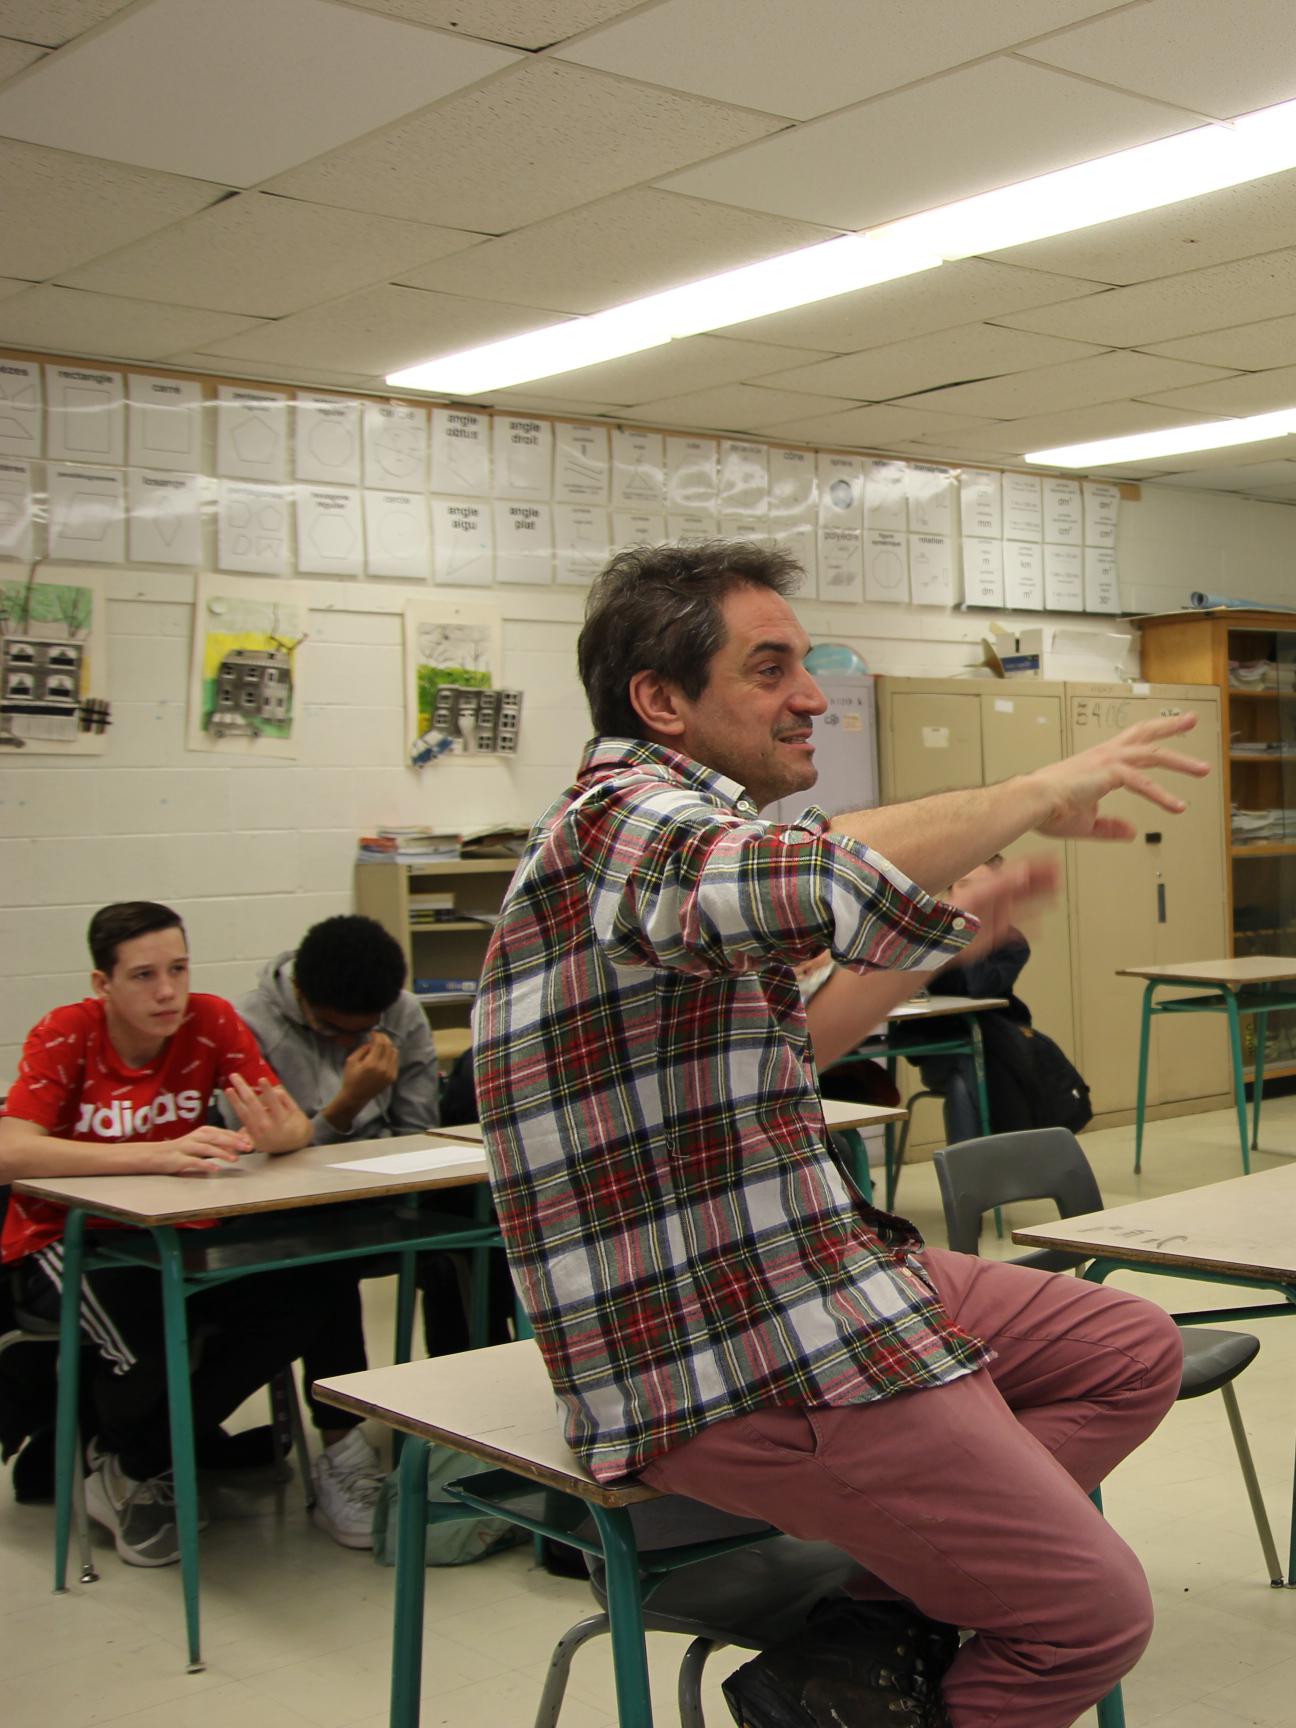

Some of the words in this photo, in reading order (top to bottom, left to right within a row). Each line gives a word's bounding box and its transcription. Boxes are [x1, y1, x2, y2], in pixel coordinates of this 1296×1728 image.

[58, 369, 114, 385] rectangle
[447, 414, 479, 428] angle
[509, 421, 541, 434] angle
[511, 434, 540, 446] droit
[783, 450, 804, 462] cône
[447, 506, 480, 519] angle
[509, 506, 540, 519] angle
[452, 519, 478, 532] aigu
[514, 520, 536, 531] plat
[977, 519, 992, 529] mm
[918, 537, 944, 545] rotation
[1020, 560, 1032, 569] km
